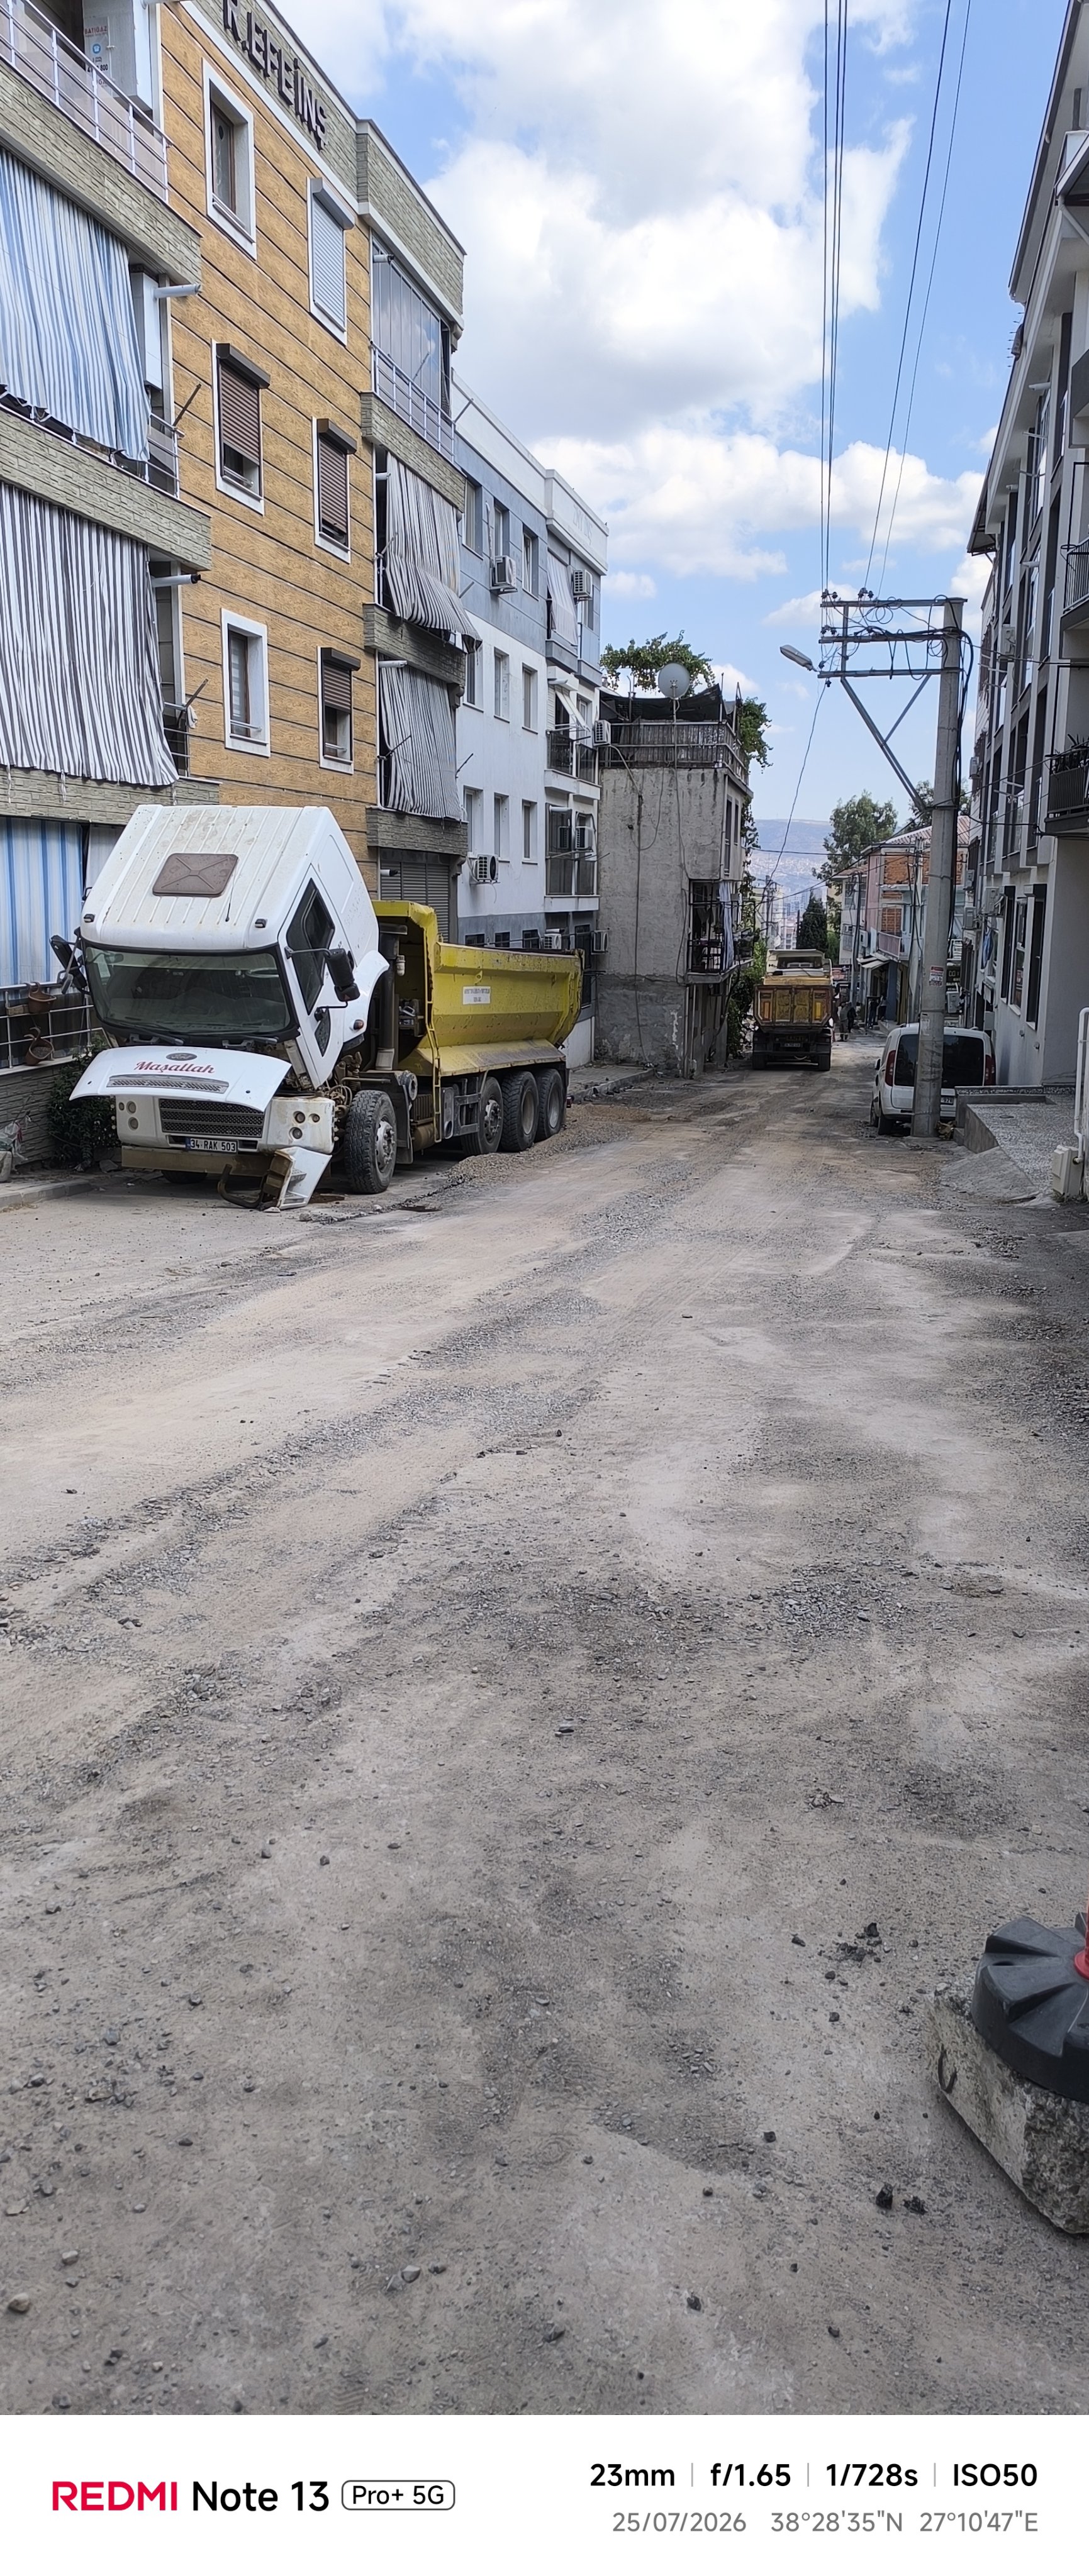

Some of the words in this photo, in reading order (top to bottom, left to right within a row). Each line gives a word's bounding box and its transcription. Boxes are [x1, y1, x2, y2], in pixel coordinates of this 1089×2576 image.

[134, 1061, 215, 1074] Maşallah
[191, 1139, 200, 1148] 34
[204, 1140, 218, 1150] RAK
[221, 1141, 236, 1152] 503
